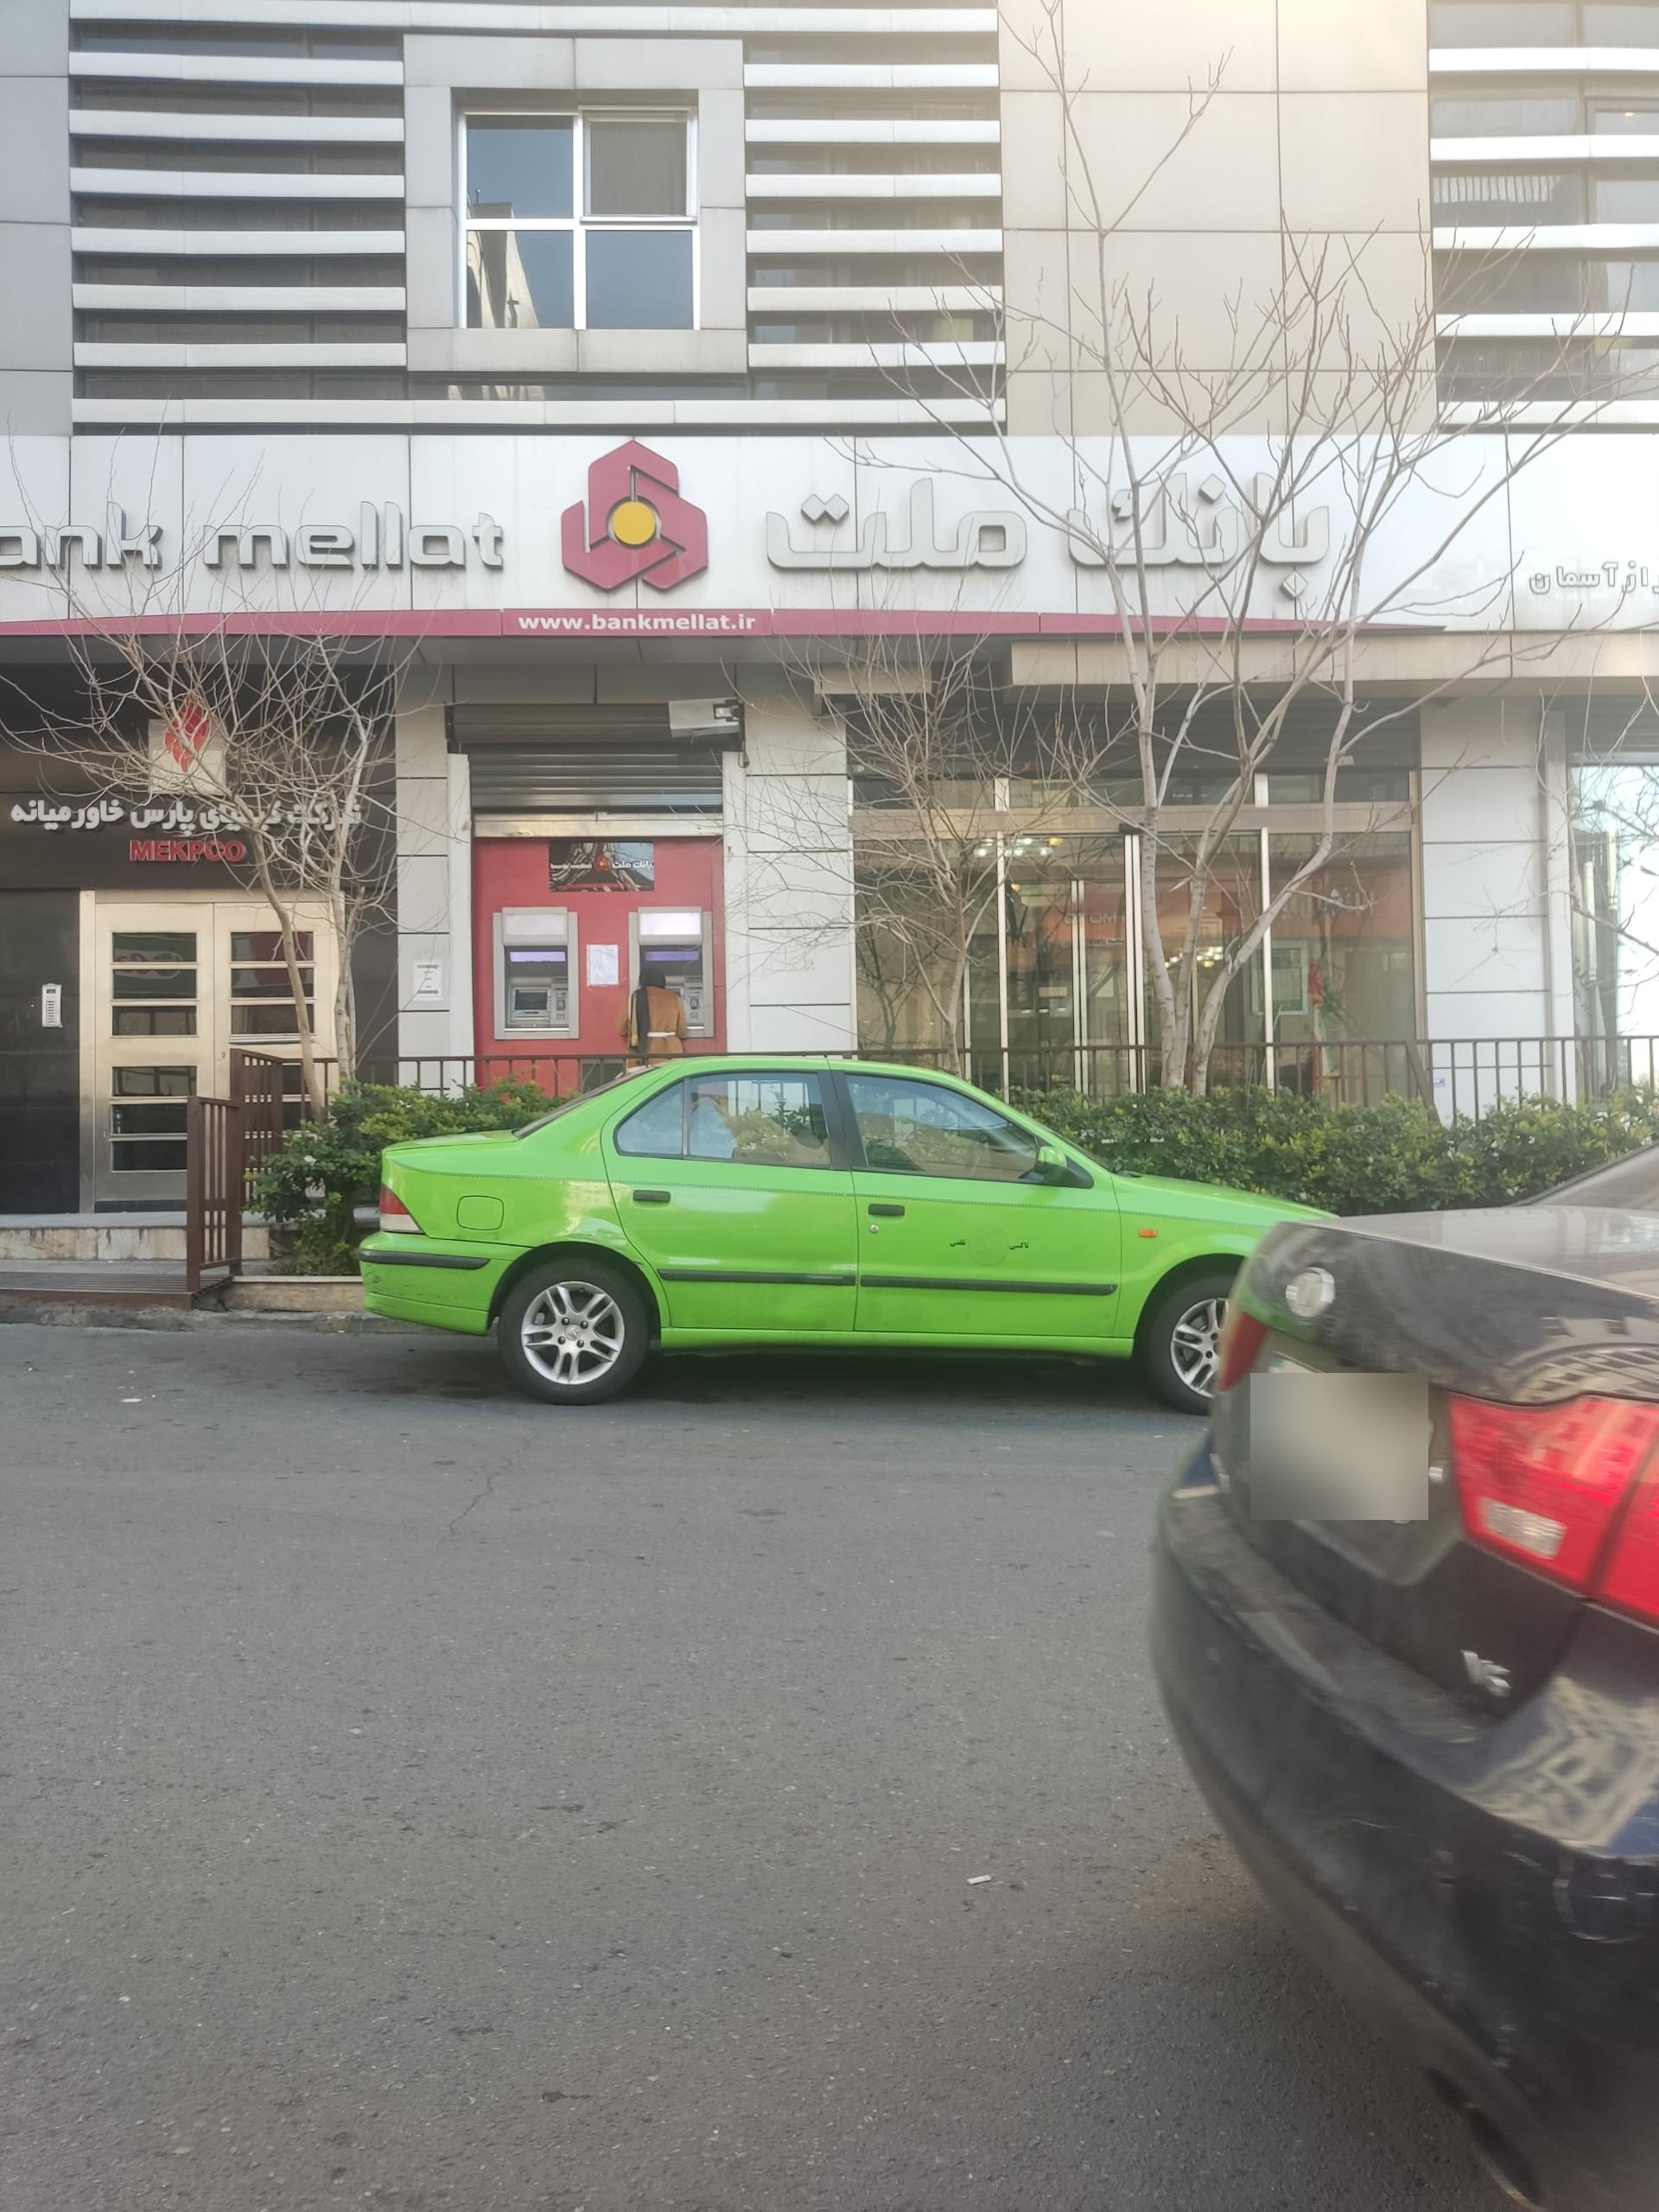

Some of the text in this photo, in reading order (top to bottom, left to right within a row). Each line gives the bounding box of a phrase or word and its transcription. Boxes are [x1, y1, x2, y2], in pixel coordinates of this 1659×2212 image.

[203, 500, 504, 569] mellat
[766, 478, 1027, 570] ملت
[1529, 561, 1619, 594] آسمان
[518, 613, 756, 631] www.bankmellat.ir
[130, 800, 194, 837] پارس
[130, 840, 246, 862] MEKPCO
